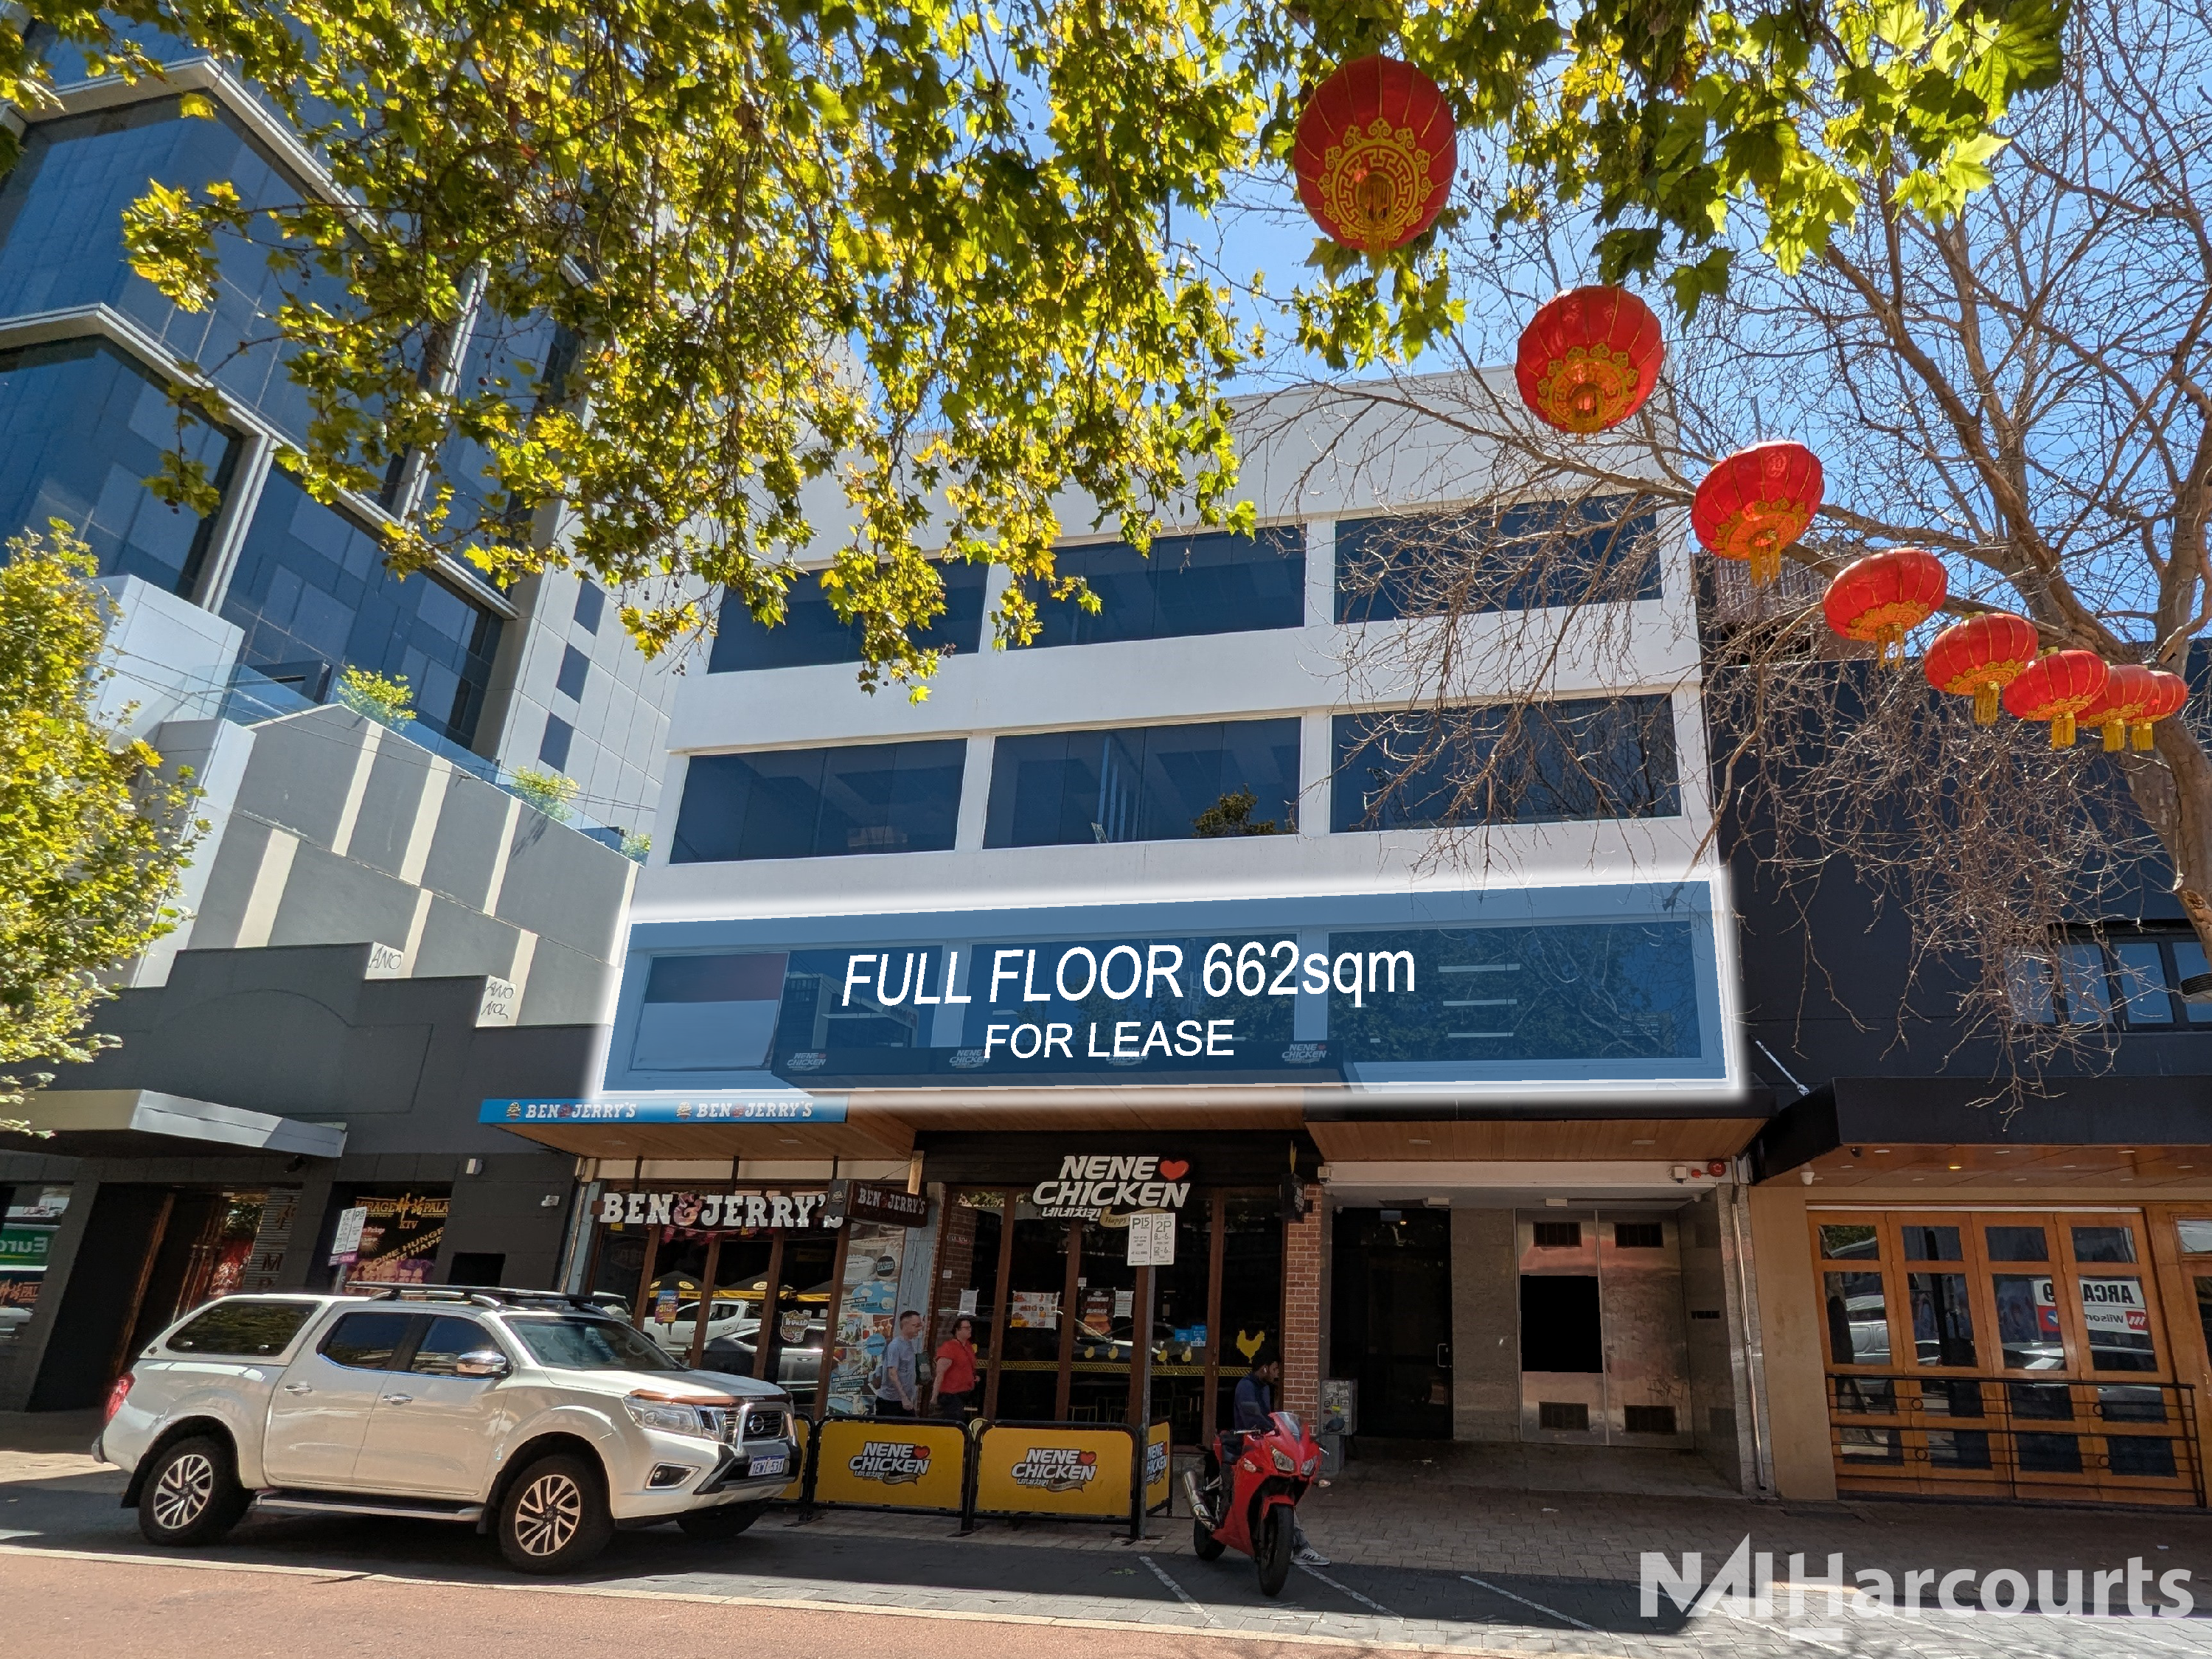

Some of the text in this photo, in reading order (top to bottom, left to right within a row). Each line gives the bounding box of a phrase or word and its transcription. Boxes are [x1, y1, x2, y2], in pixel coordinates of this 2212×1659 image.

[1281, 1050, 1326, 1059] CHICKEN
[1290, 1043, 1318, 1051] NENE
[949, 1056, 990, 1064] CHICKEN
[525, 1104, 560, 1119] BEN
[571, 1102, 637, 1119] JERRY'S
[696, 1103, 732, 1118] BEN
[745, 1100, 814, 1118] JERRY'S
[1058, 1155, 1160, 1180] NENE
[858, 1187, 882, 1208] BEN
[887, 1193, 926, 1215] JERRY'S
[1032, 1181, 1191, 1208] CHICKEN
[599, 1192, 673, 1225] BEN
[1155, 1220, 1172, 1233] 2P
[862, 1441, 914, 1458] NENE
[1026, 1448, 1080, 1464] NENE
[849, 1455, 930, 1475] CHICKEN
[1011, 1463, 1096, 1481] CHICKEN
